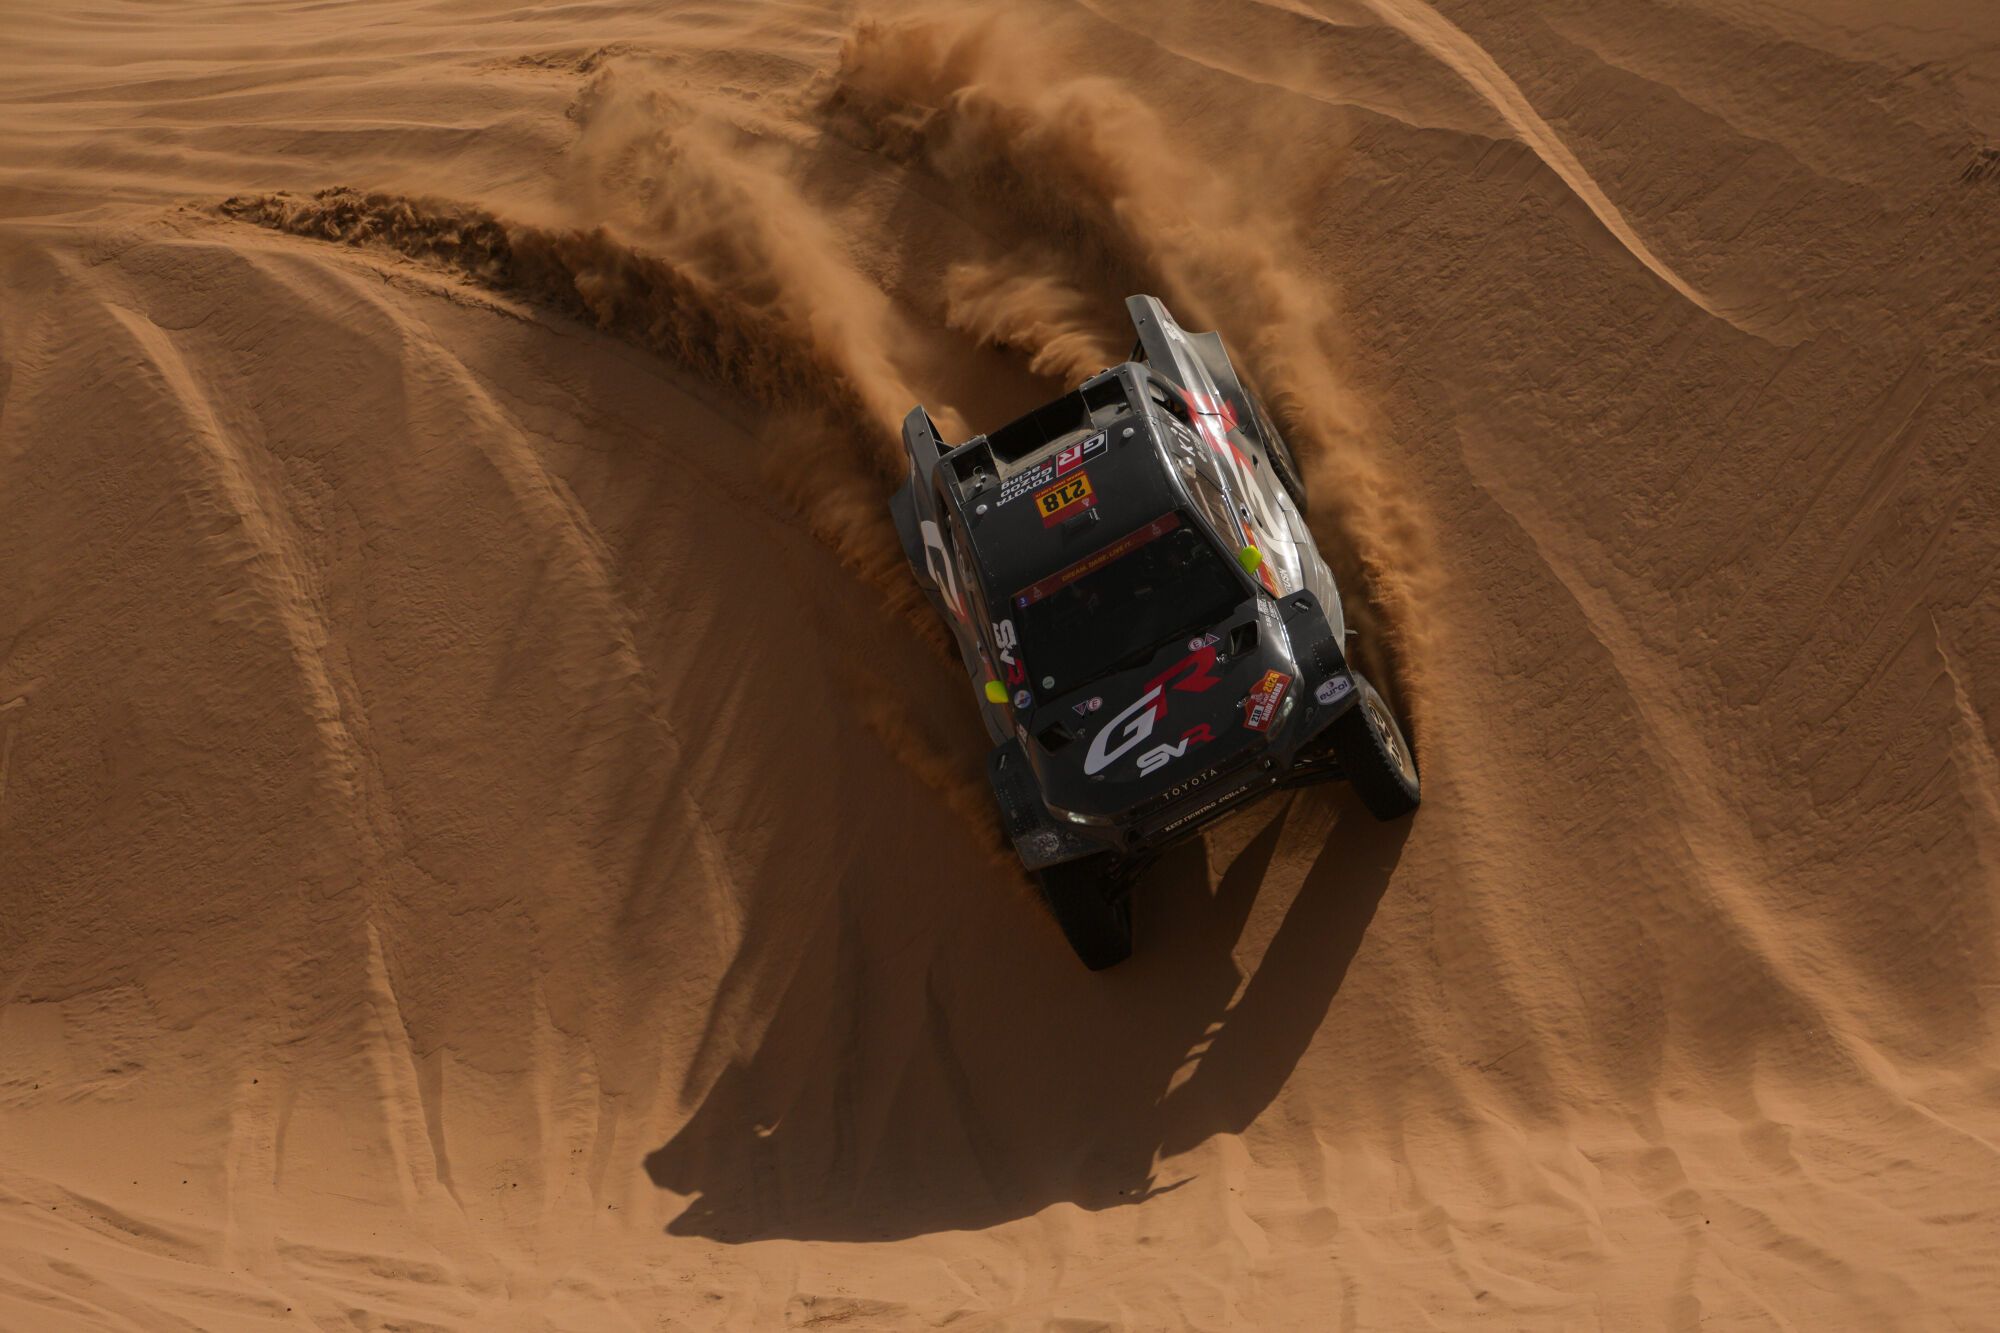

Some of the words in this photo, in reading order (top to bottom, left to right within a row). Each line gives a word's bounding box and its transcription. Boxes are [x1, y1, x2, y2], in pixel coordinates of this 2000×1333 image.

[1058, 432, 1106, 466] GR
[996, 473, 1054, 507] TOYOTA
[1000, 466, 1053, 498] GAZOO
[1001, 459, 1054, 491] Racing
[1042, 480, 1086, 513] 218
[1319, 680, 1348, 701] eurol
[1083, 646, 1222, 776] GR
[1251, 708, 1262, 722] 218
[1136, 722, 1217, 779] SVR
[1162, 769, 1218, 801] TOYOTA
